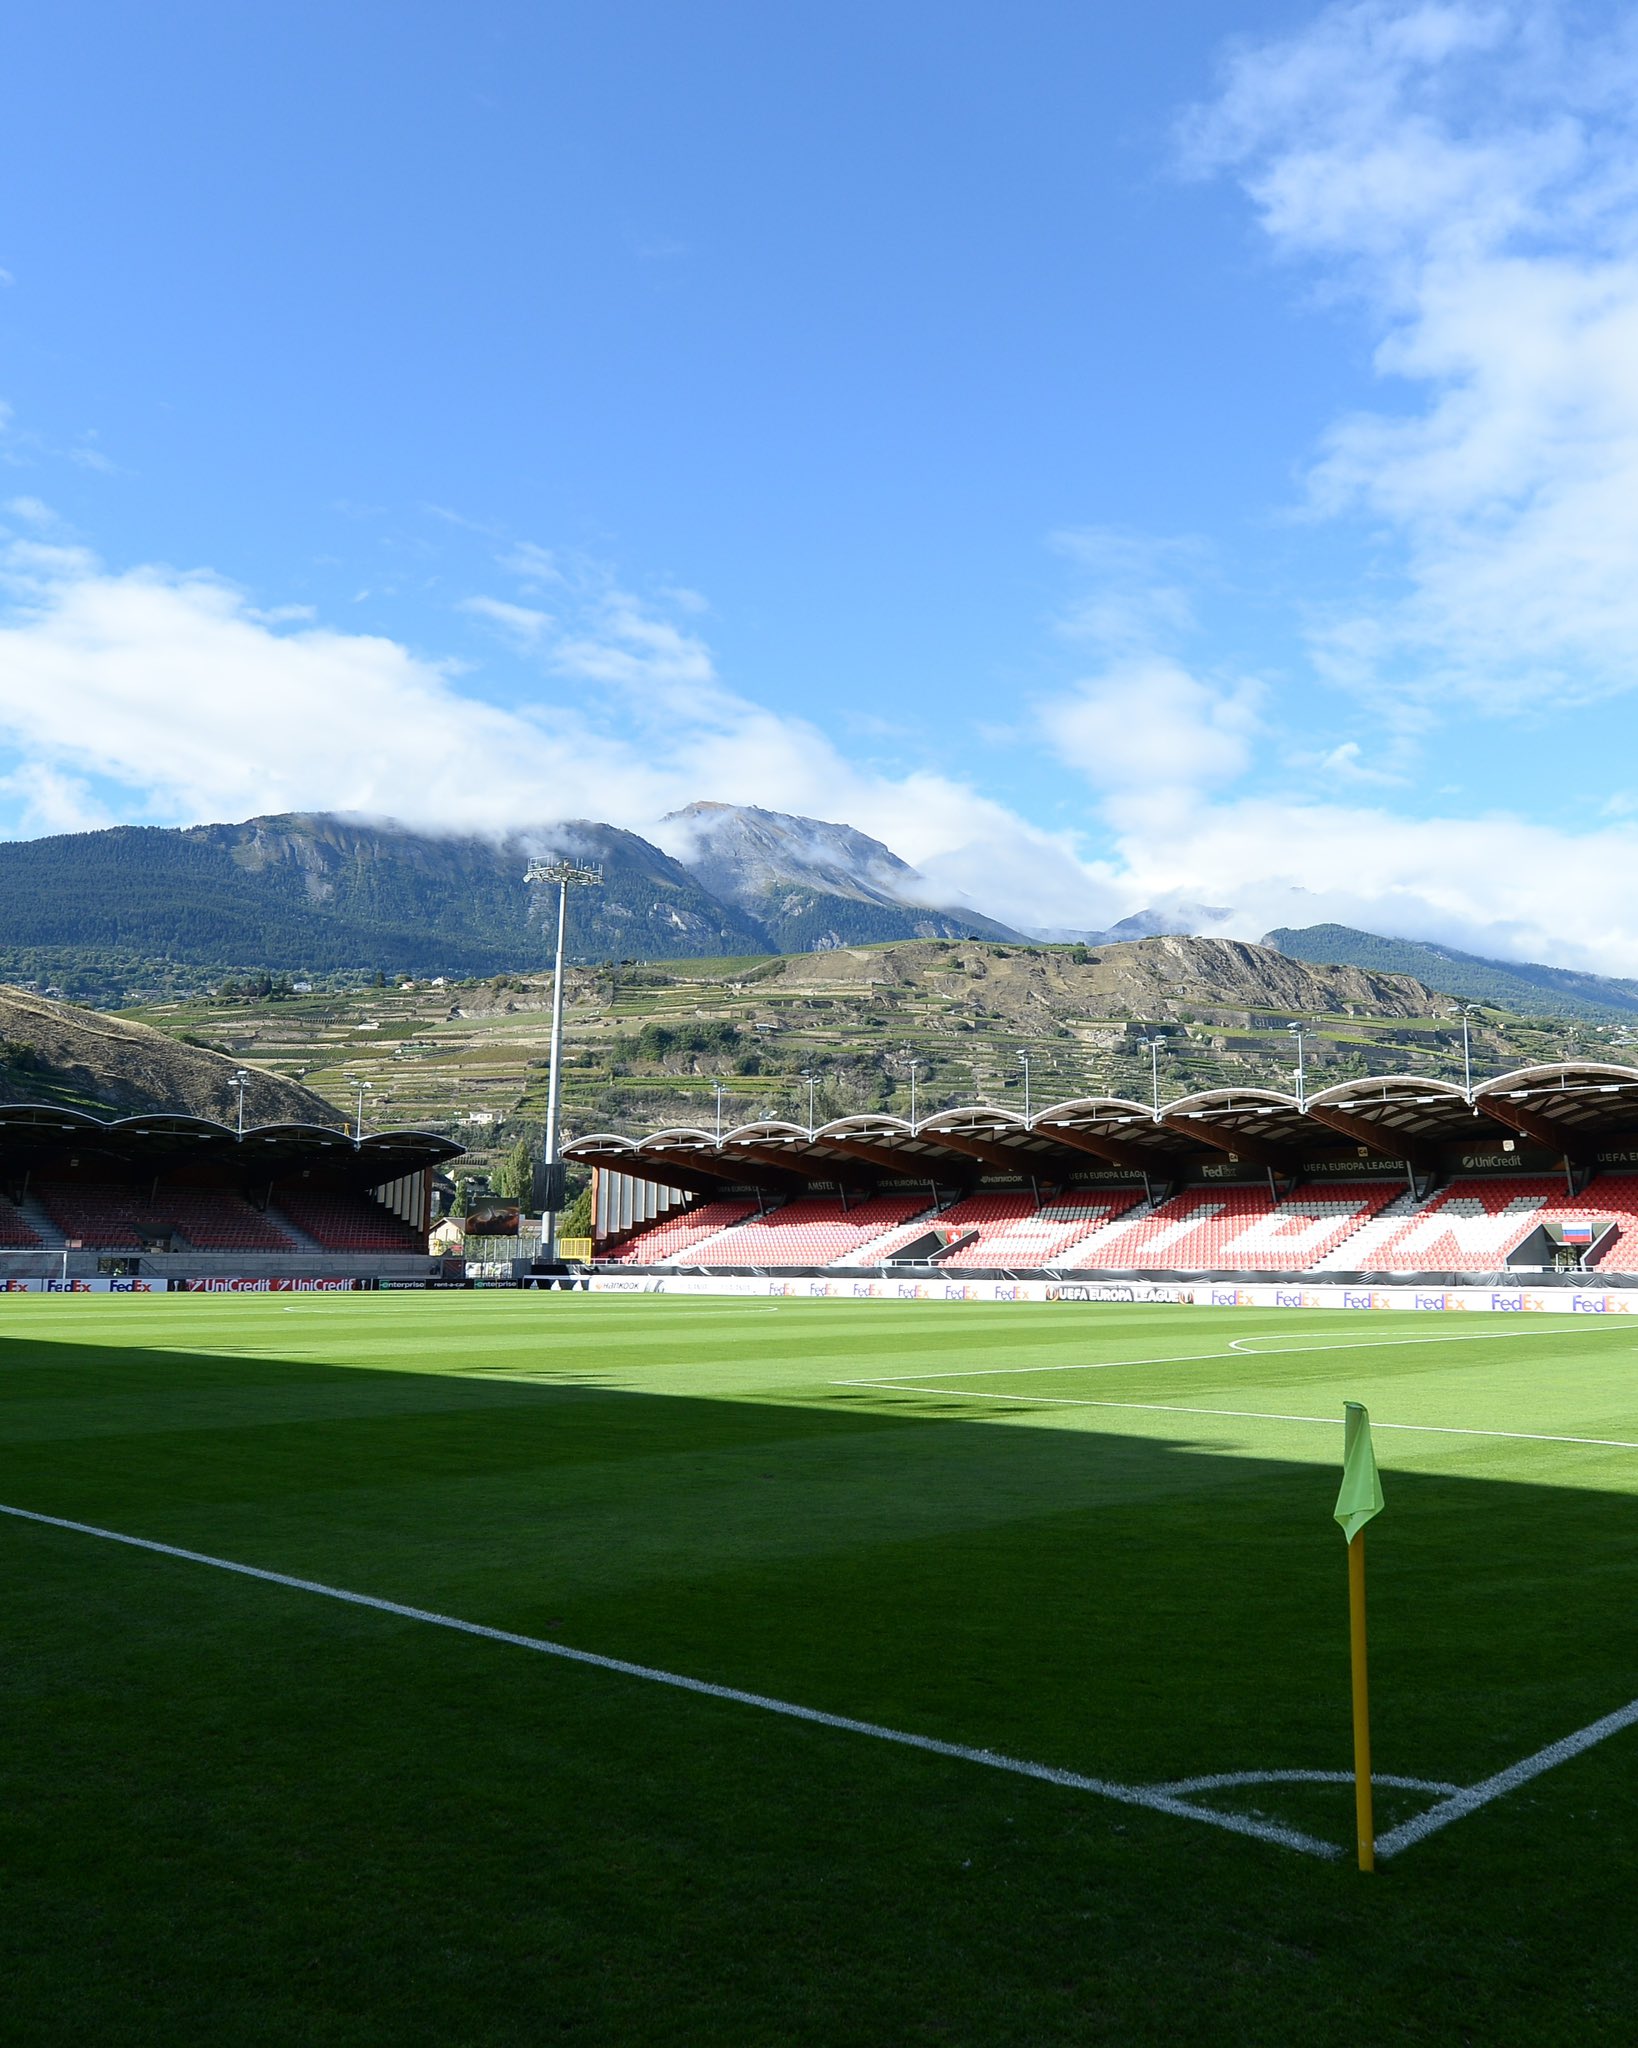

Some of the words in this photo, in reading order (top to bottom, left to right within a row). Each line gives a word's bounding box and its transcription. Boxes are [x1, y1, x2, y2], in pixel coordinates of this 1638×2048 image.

[1476, 1155, 1522, 1167] UniCredit
[1597, 1153, 1628, 1162] UEFA
[1303, 1163, 1328, 1171] UEFA
[1329, 1162, 1365, 1171] EUROPA
[1366, 1160, 1405, 1170] LEAGUE
[1069, 1172, 1089, 1180] UEFA
[1090, 1171, 1119, 1180] EUROPA
[808, 1182, 834, 1192] AMSTEL
[48, 1280, 91, 1292] FedEx
[110, 1280, 152, 1292] FedEx
[205, 1279, 271, 1292] UniCredit
[292, 1279, 355, 1292] UniCredit
[381, 1280, 425, 1289] enterprise
[769, 1283, 796, 1297] FedEx
[810, 1284, 839, 1297] FedEx
[853, 1284, 882, 1298] FedEx
[898, 1285, 929, 1299] FedEx
[945, 1286, 978, 1300] FedEx
[995, 1287, 1029, 1301] FedEx
[1059, 1287, 1088, 1301] UEFA
[1090, 1287, 1133, 1302] EUROPA
[1135, 1289, 1180, 1303] LEAGUE
[1211, 1290, 1254, 1307] FedEx
[1276, 1291, 1320, 1307] FedEx
[1343, 1292, 1390, 1309] FedEx
[1415, 1294, 1465, 1311] FedEx
[1491, 1294, 1544, 1311] FedEx
[1572, 1295, 1629, 1313] FedEx
